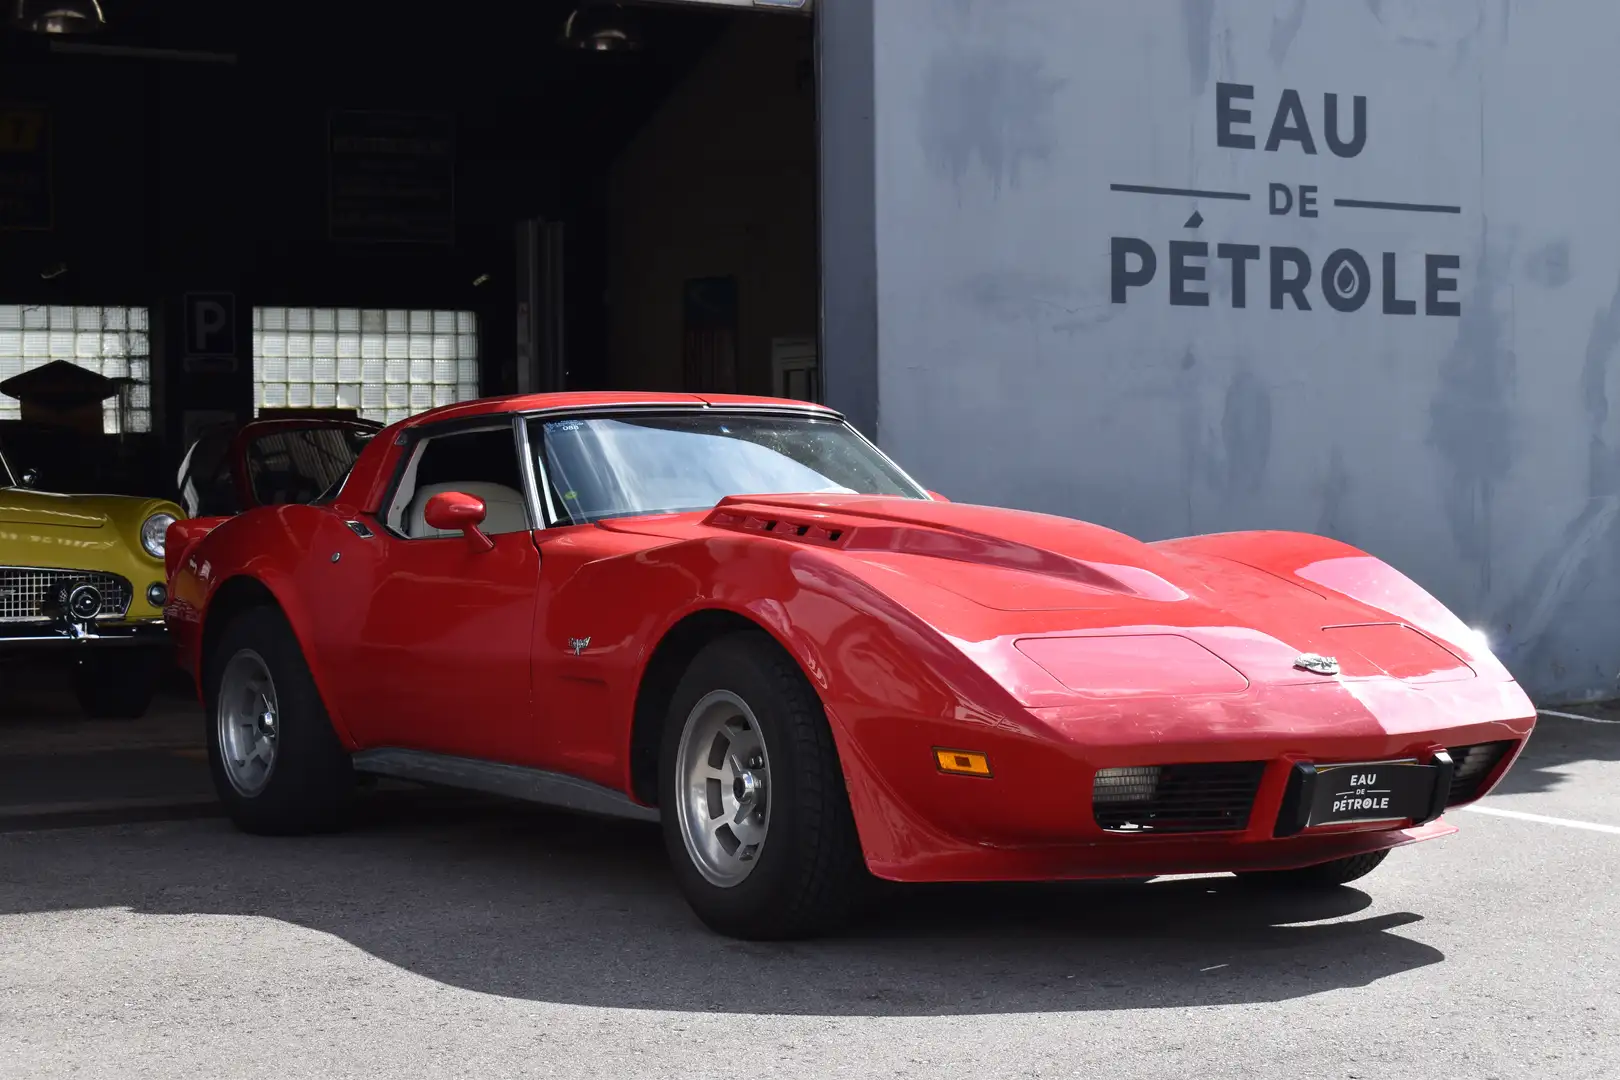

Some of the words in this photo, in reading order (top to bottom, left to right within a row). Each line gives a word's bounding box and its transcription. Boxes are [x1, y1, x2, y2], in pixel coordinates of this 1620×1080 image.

[1216, 82, 1367, 158] EAU
[1269, 183, 1318, 218] DE
[1111, 210, 1461, 316] PÉTROLE
[195, 301, 226, 350] P
[1350, 773, 1377, 786] EAU
[1332, 795, 1390, 813] PÉTROLE
